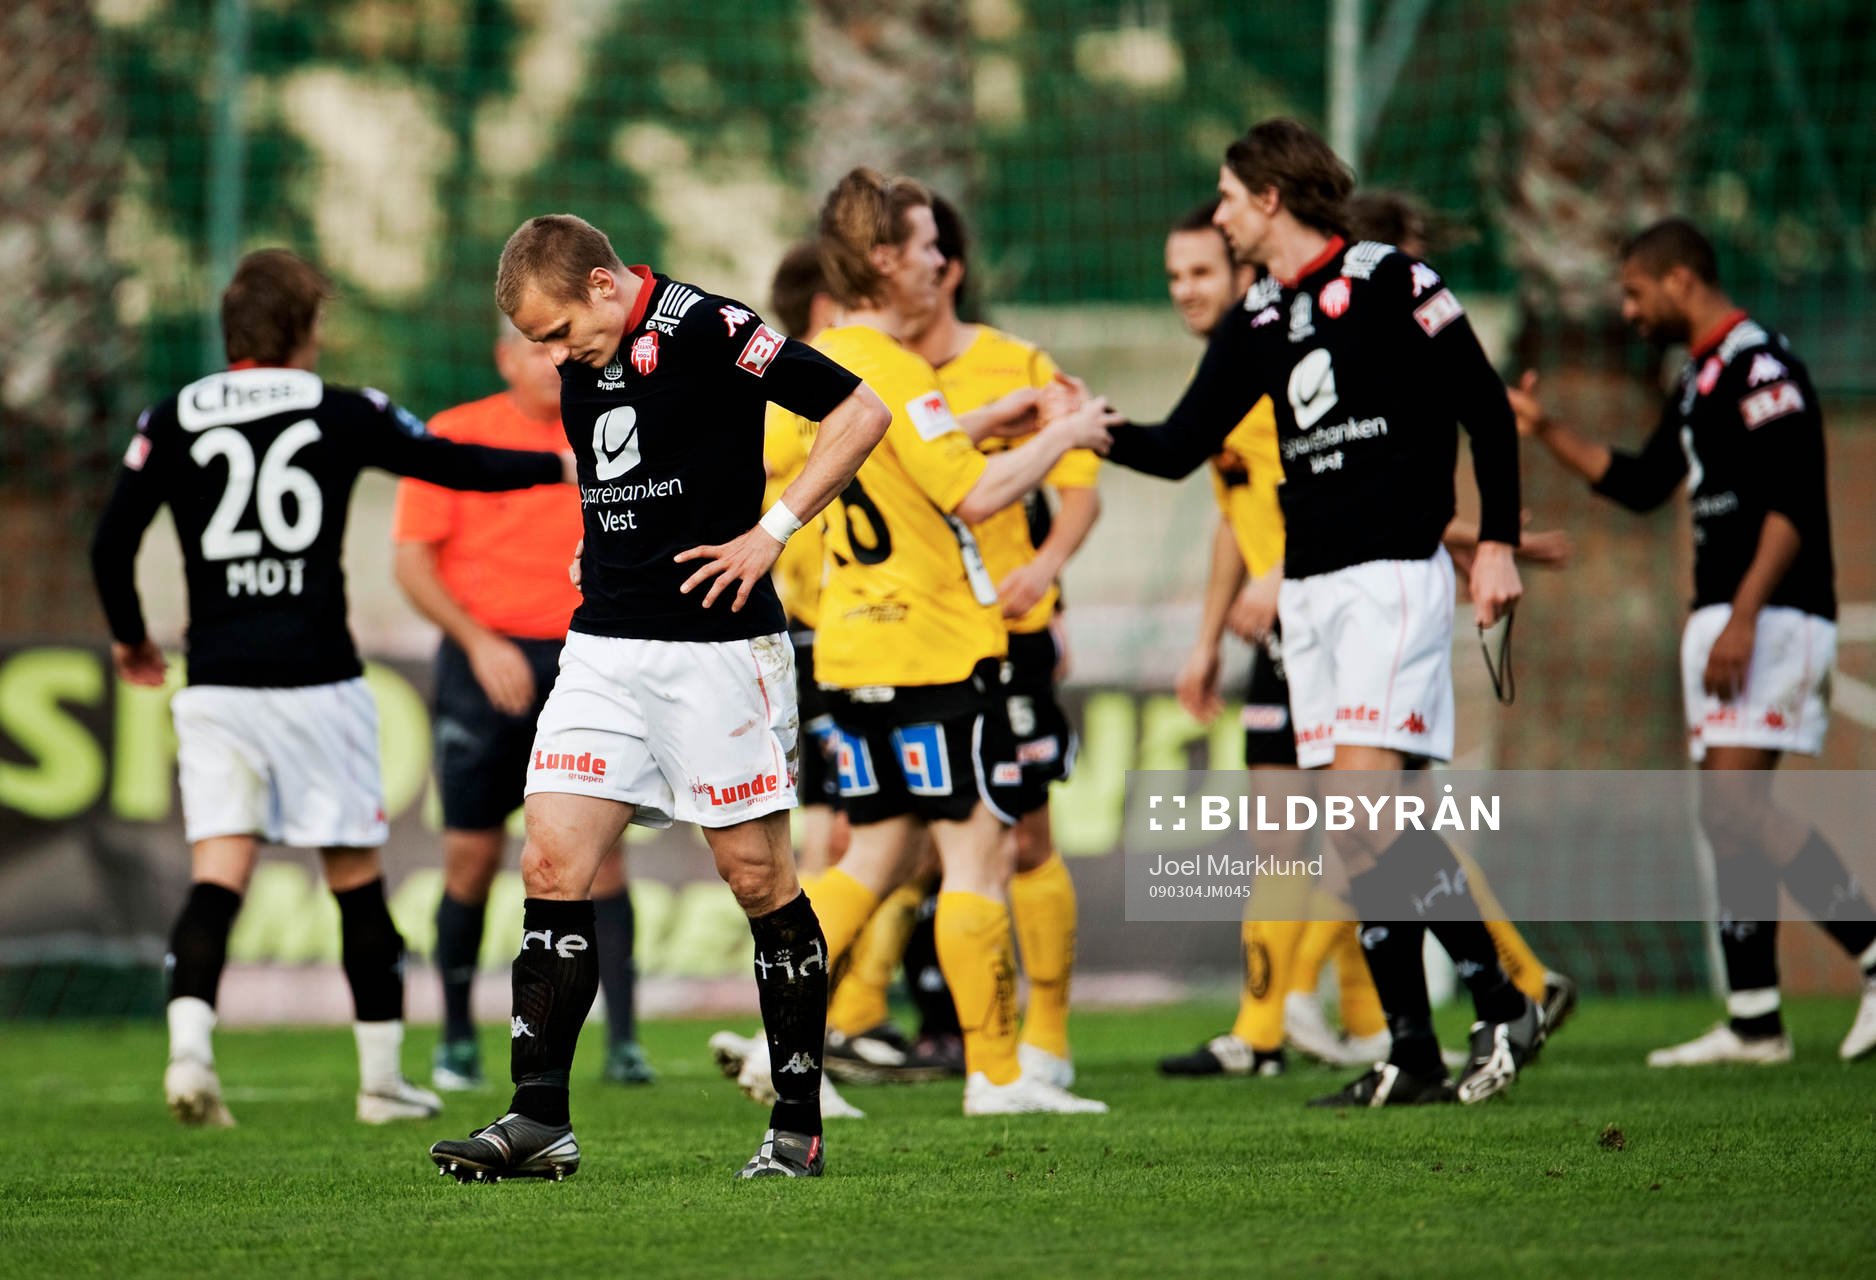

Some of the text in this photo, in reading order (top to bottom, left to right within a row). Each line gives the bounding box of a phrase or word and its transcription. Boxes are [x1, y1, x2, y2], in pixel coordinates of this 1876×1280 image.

[189, 418, 322, 561] 26
[598, 509, 637, 532] Vest
[226, 558, 305, 597] MOT
[535, 750, 606, 775] Lunde
[568, 772, 604, 783] gruppen
[708, 774, 777, 806] Lunde
